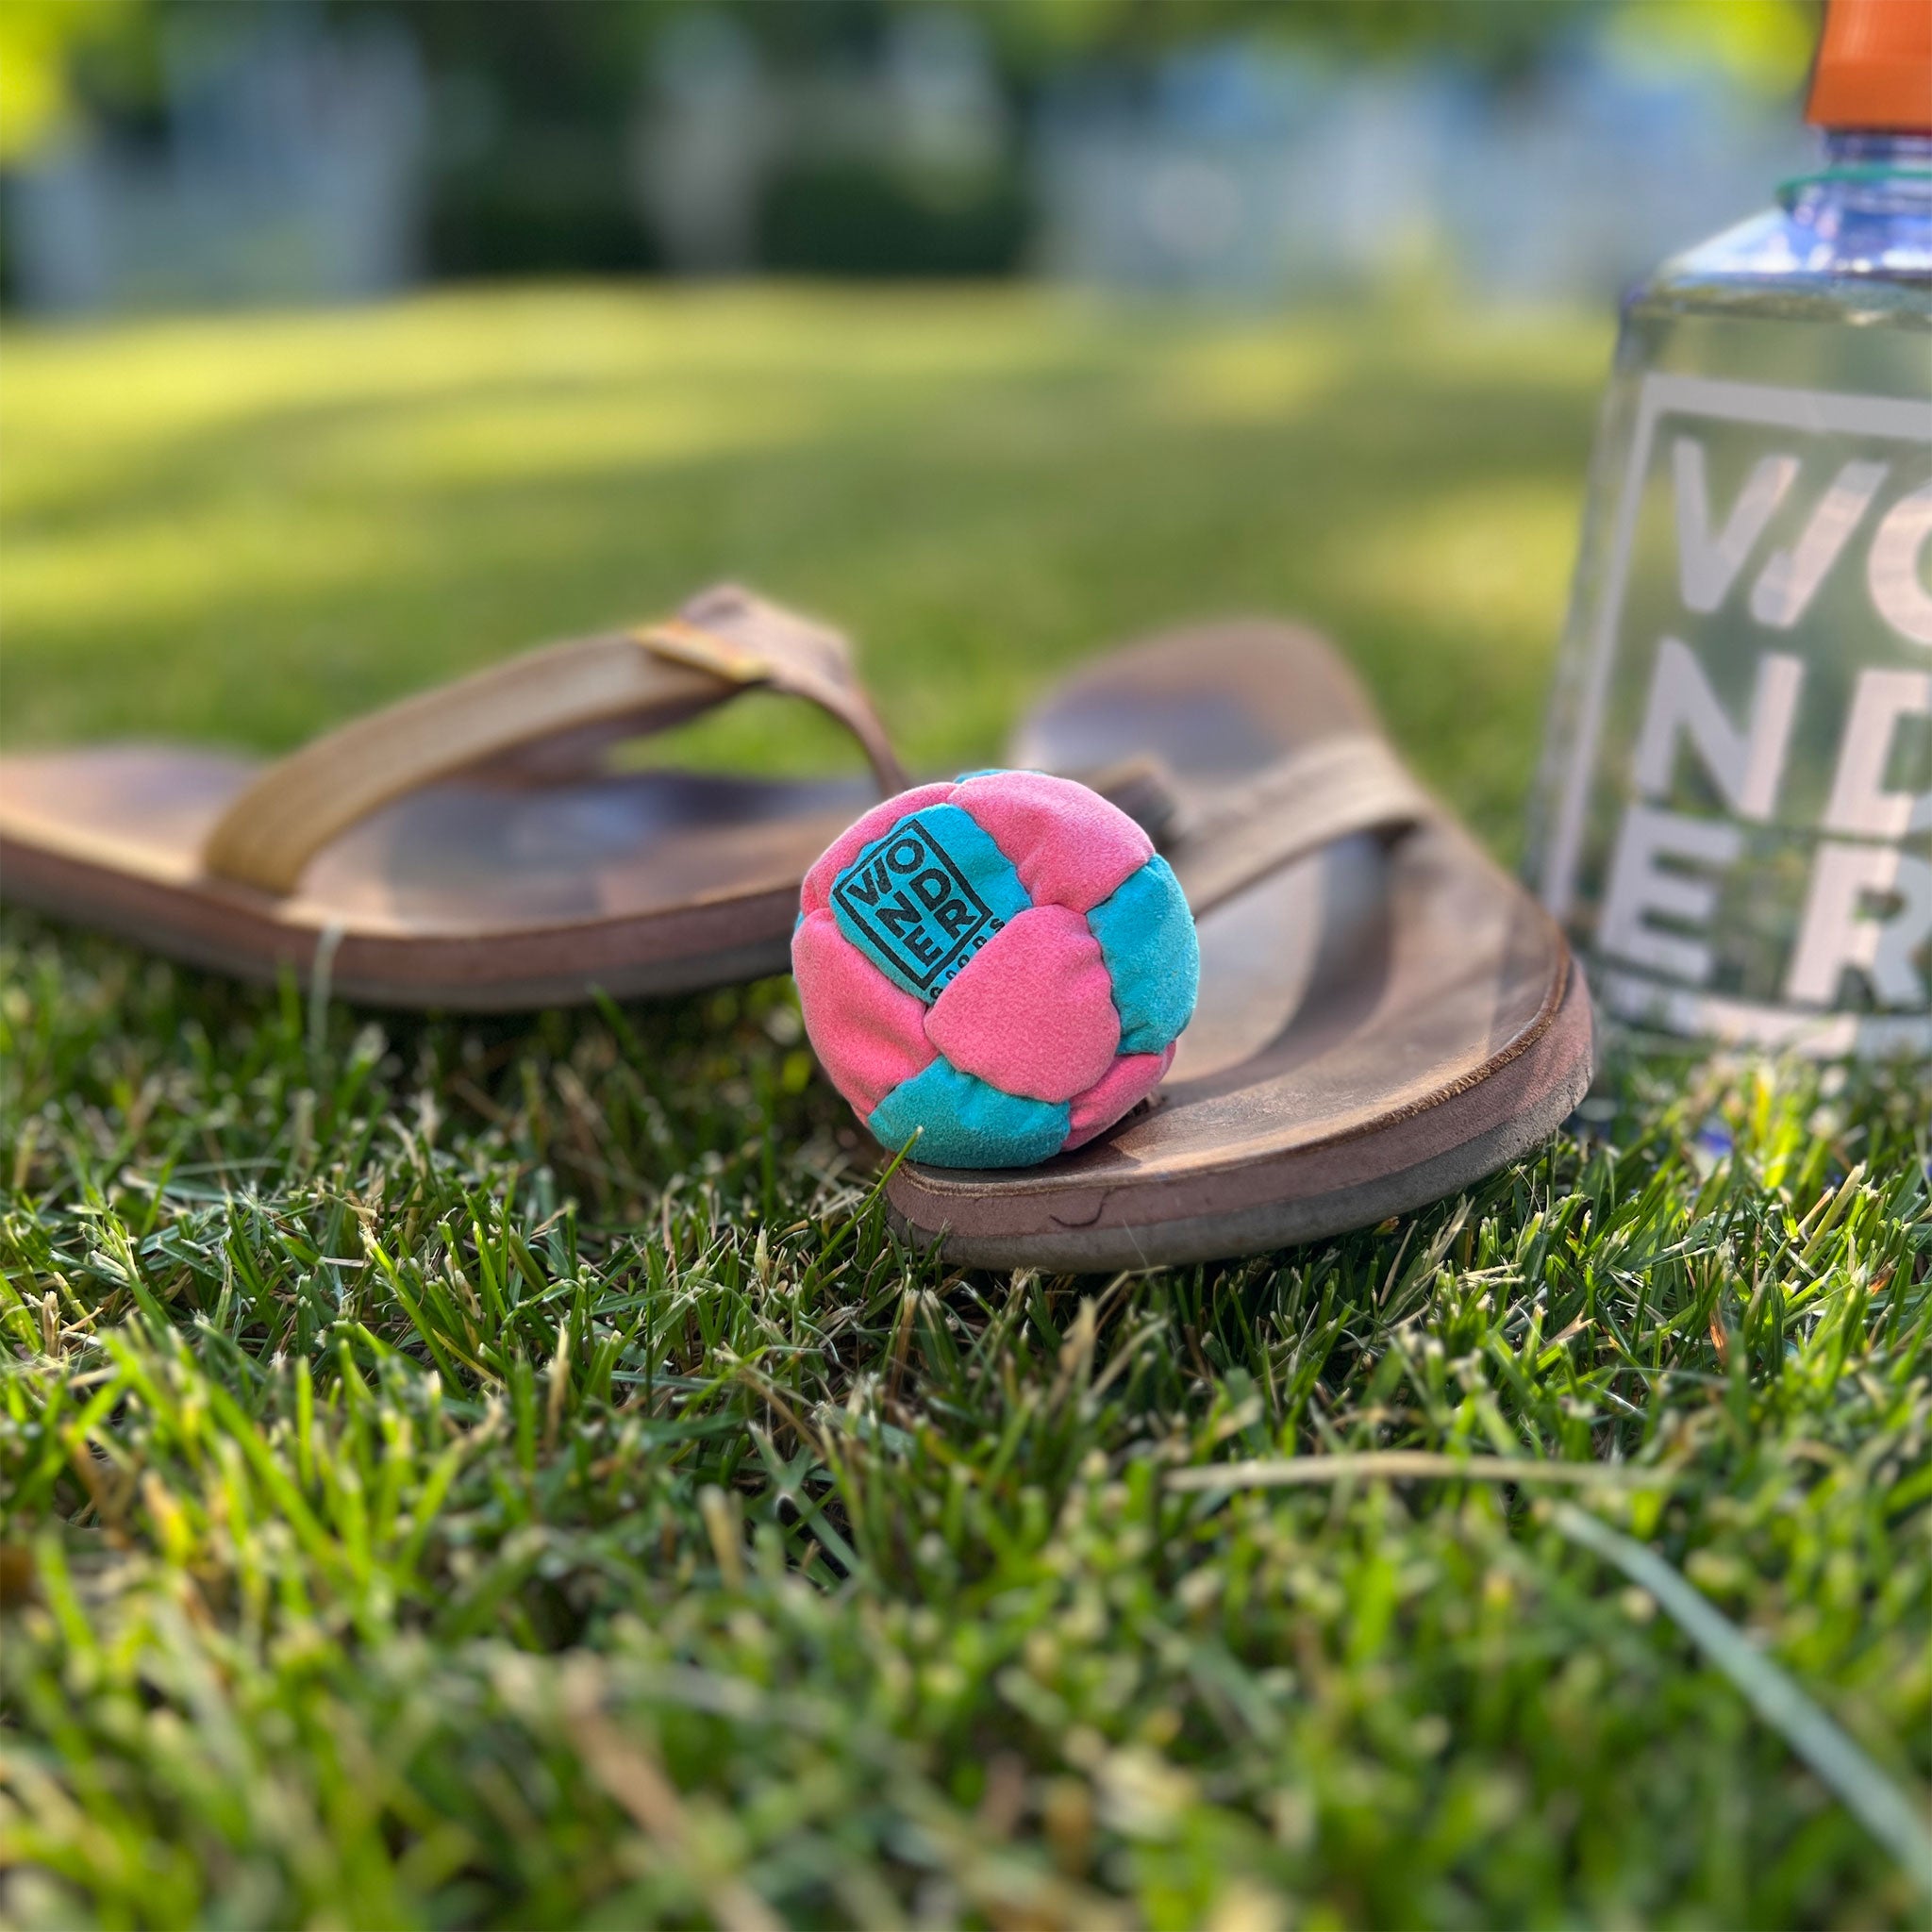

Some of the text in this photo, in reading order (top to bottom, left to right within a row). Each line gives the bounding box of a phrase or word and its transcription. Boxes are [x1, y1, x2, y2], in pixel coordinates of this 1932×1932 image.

[846, 838, 924, 907] WO
[874, 868, 951, 939] ND
[902, 899, 977, 967] ER
